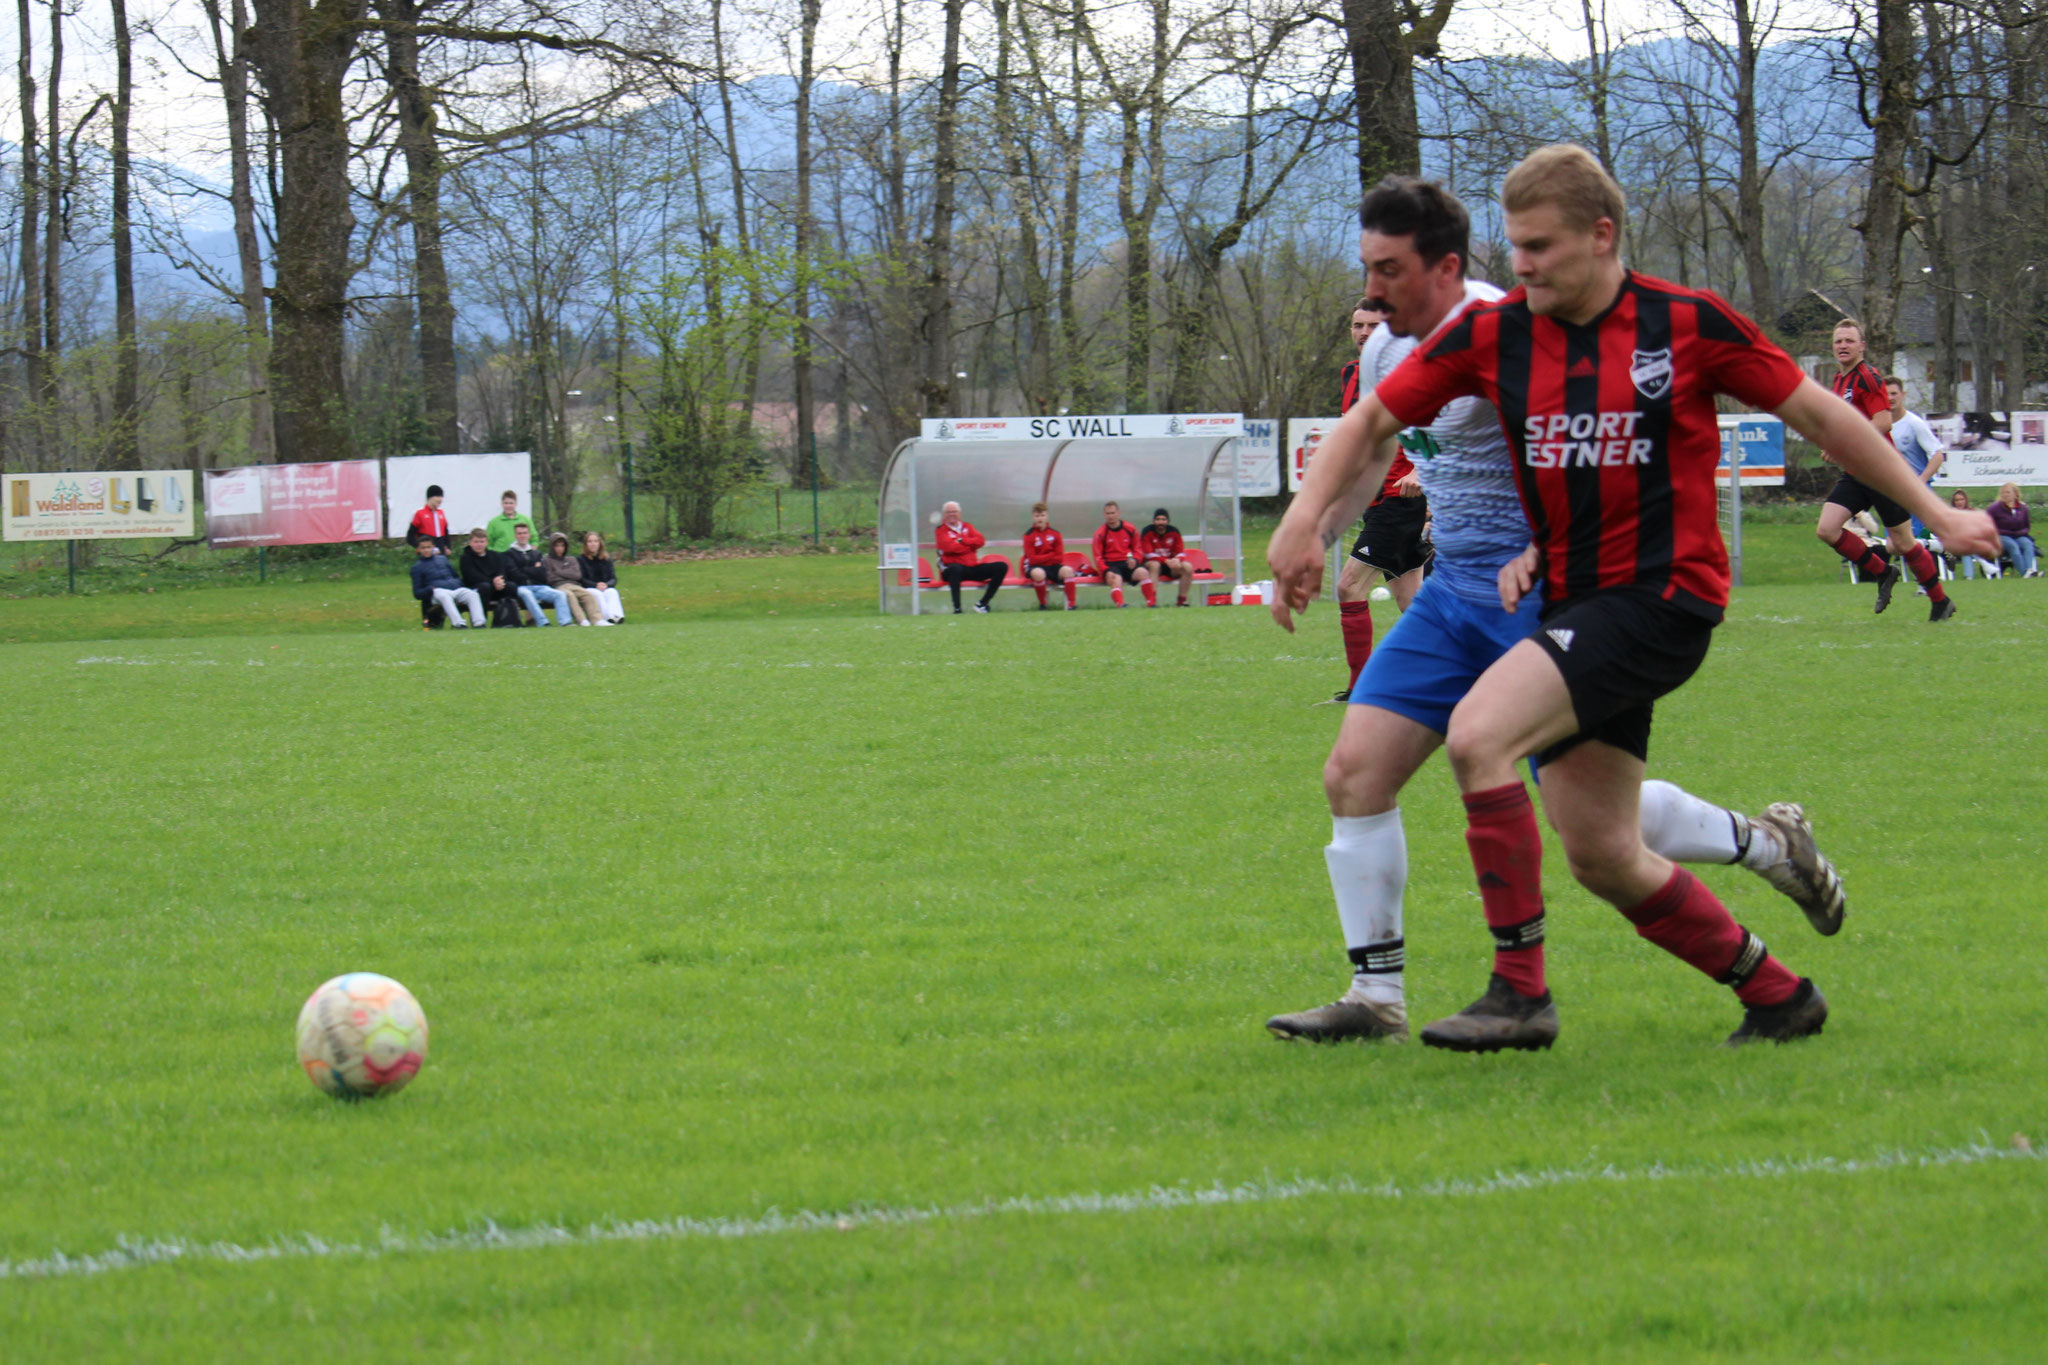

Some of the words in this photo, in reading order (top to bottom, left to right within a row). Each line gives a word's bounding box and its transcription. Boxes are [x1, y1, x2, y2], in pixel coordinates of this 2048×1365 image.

[1030, 419, 1060, 438] SC
[1068, 418, 1132, 437] WALL
[1243, 423, 1270, 438] HN
[1524, 411, 1645, 440] SPORT
[1525, 438, 1653, 468] ESTNER
[36, 494, 104, 512] Waldland
